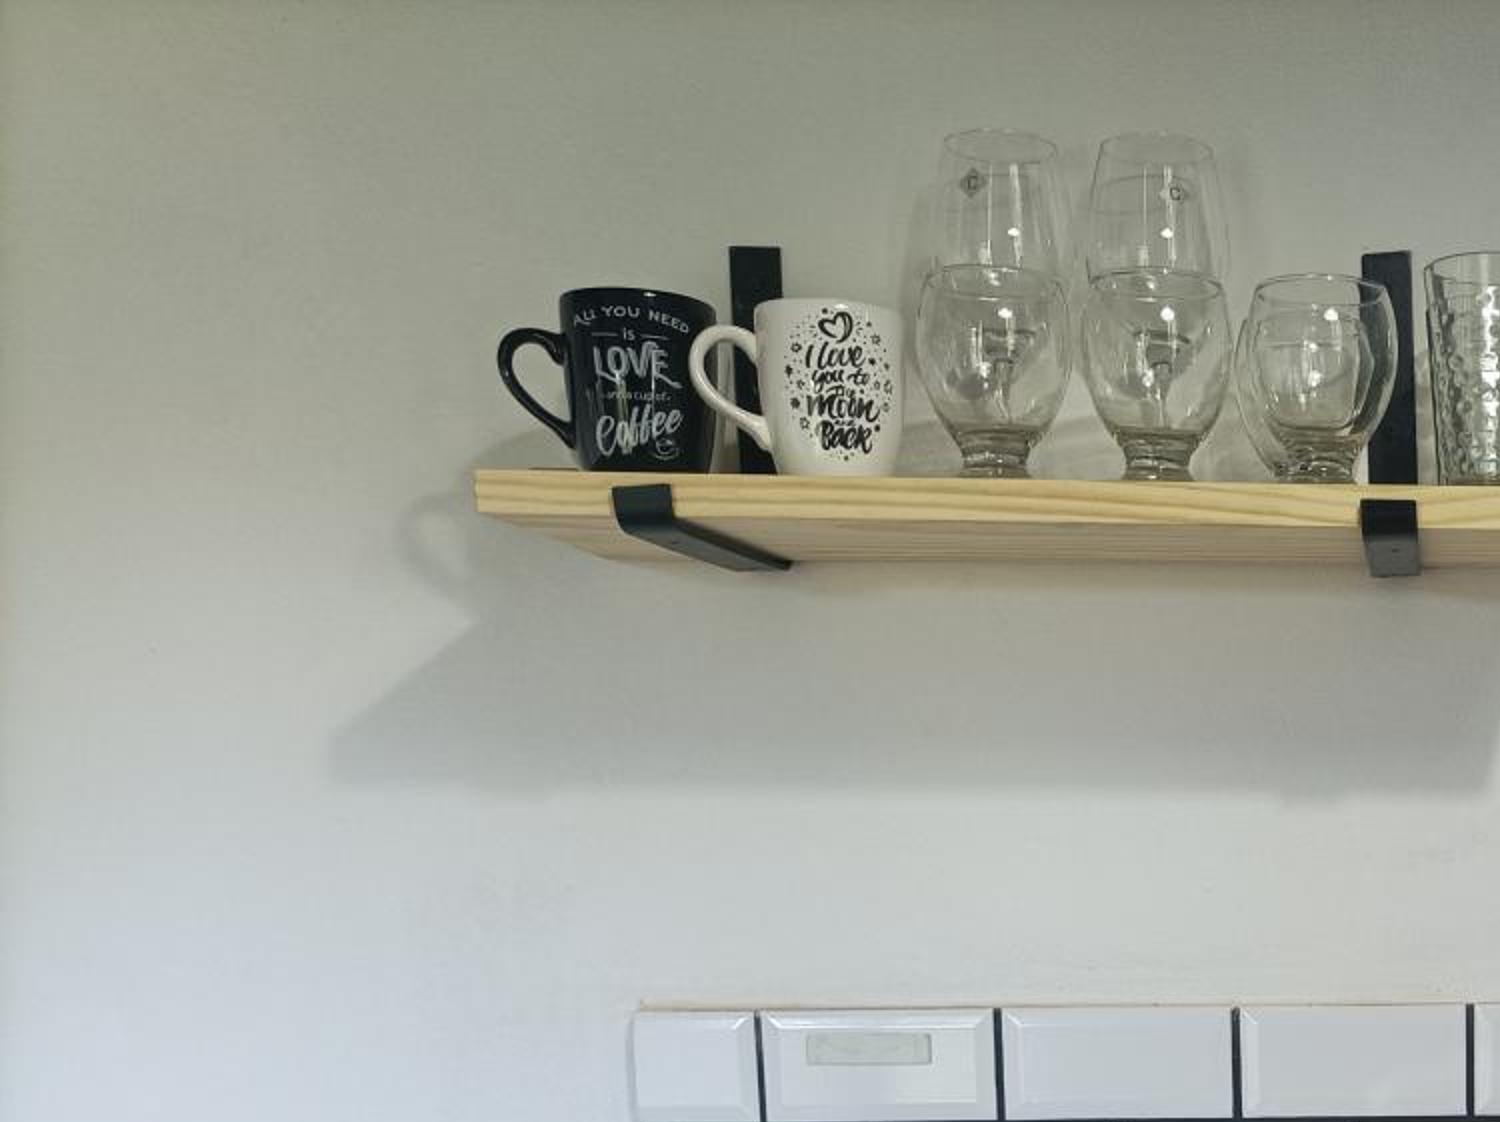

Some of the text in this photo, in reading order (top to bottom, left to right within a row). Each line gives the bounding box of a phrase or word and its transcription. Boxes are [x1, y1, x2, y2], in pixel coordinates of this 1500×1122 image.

[573, 305, 689, 333] ALL YOU NEED
[593, 341, 683, 389] LOVE
[805, 341, 866, 370] I love
[811, 368, 870, 394] you to
[596, 403, 684, 457] Coffee
